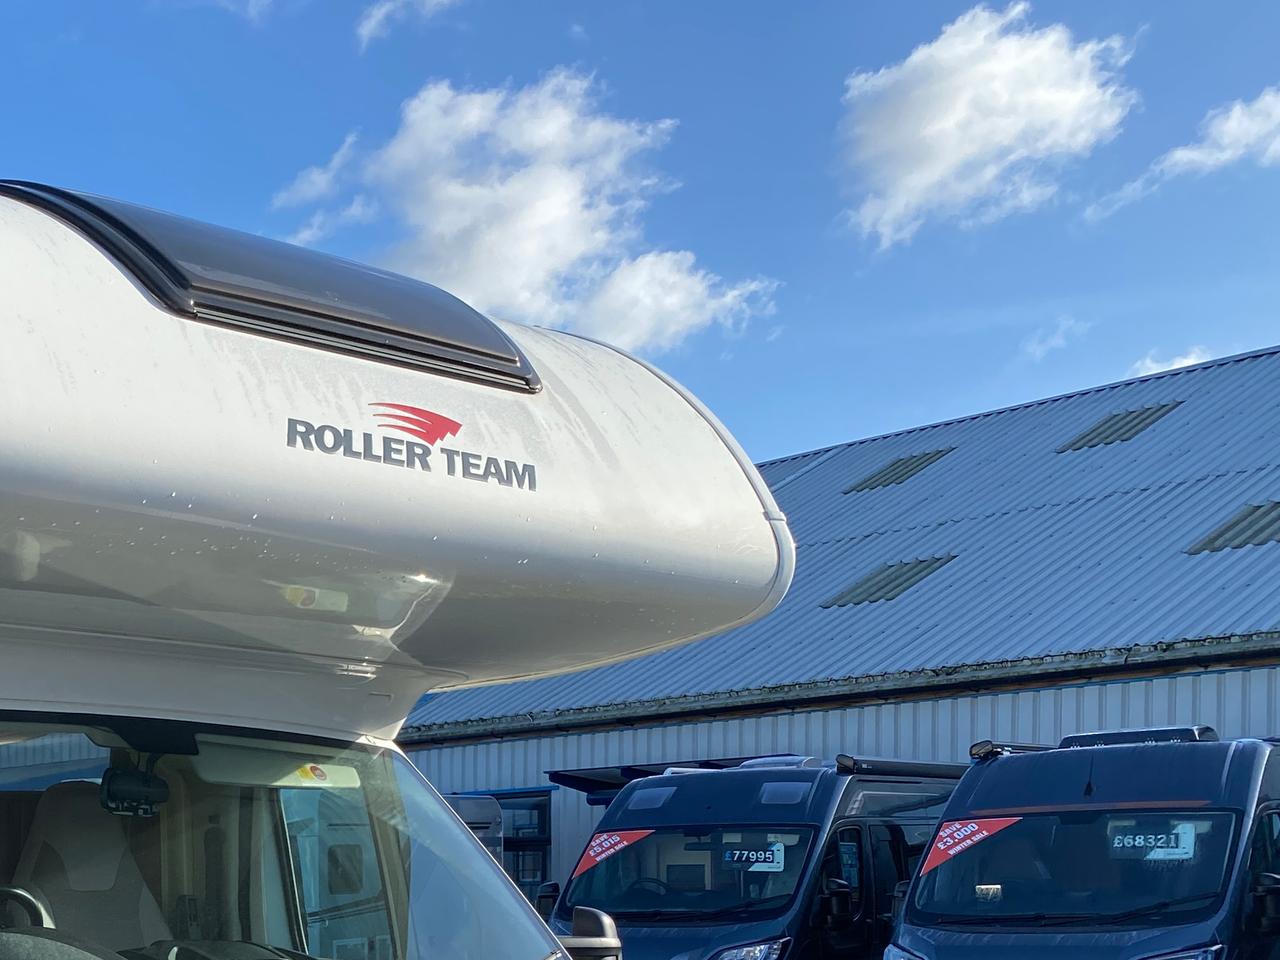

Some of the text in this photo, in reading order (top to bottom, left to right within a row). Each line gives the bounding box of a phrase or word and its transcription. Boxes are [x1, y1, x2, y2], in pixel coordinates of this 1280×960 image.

[286, 417, 538, 492] ROLLER TEAM
[940, 822, 962, 838] SAVE
[1112, 834, 1177, 848] £68321
[724, 850, 773, 862] £77995
